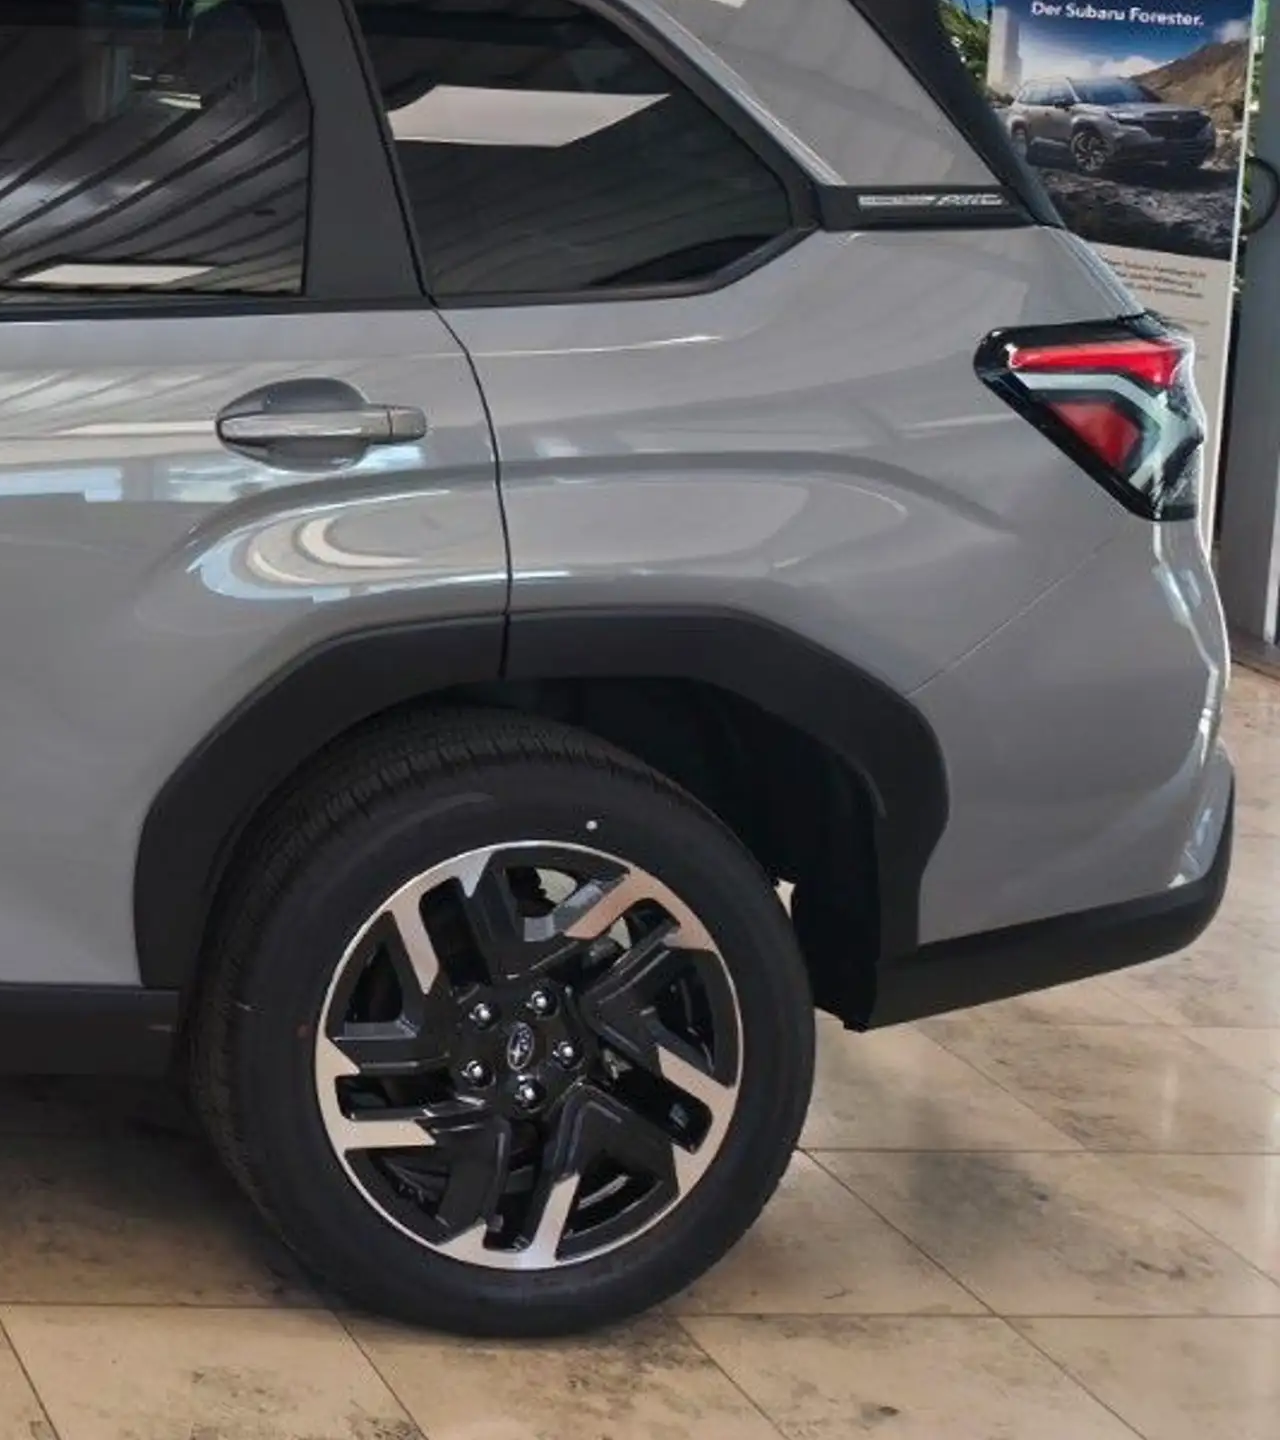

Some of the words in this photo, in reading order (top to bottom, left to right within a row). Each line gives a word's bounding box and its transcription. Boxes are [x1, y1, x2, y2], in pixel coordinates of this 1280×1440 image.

[1032, 0, 1062, 17] Der
[1066, 2, 1126, 22] Subaru
[1129, 7, 1205, 28] Forester.
